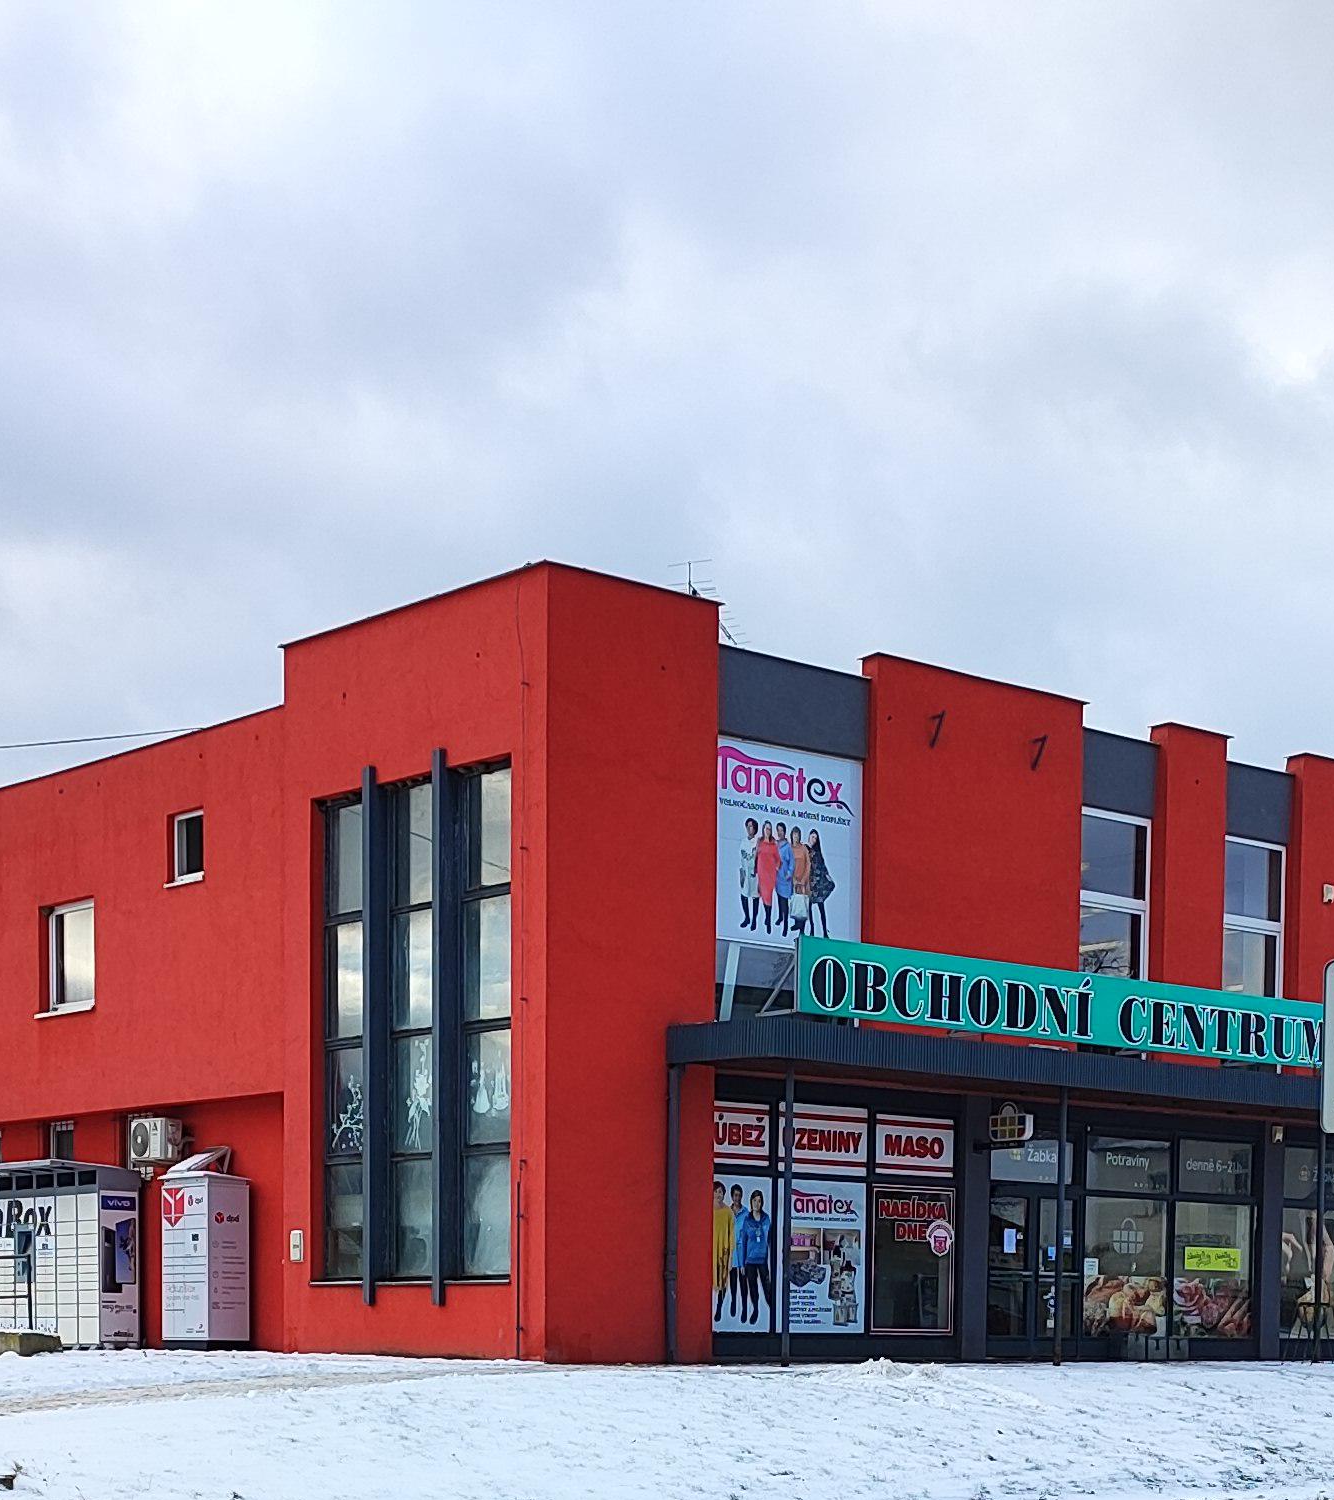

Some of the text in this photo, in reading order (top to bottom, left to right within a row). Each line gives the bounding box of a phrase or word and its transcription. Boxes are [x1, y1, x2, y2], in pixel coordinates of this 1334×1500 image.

[717, 745, 855, 817] Tanatex
[810, 955, 1094, 1040] OBCHODNÍ
[1118, 995, 1323, 1066] CENTRUM
[714, 1112, 766, 1148] ŮBEŽ
[784, 1127, 863, 1154] ZENINY
[884, 1133, 945, 1160] MASO
[1027, 1144, 1057, 1163] Žabka
[1105, 1151, 1150, 1171] Potraviny
[1185, 1157, 1214, 1172] denně
[791, 1188, 860, 1219] anatex
[879, 1196, 948, 1221] NABÍDKA
[895, 1222, 928, 1242] DNE
